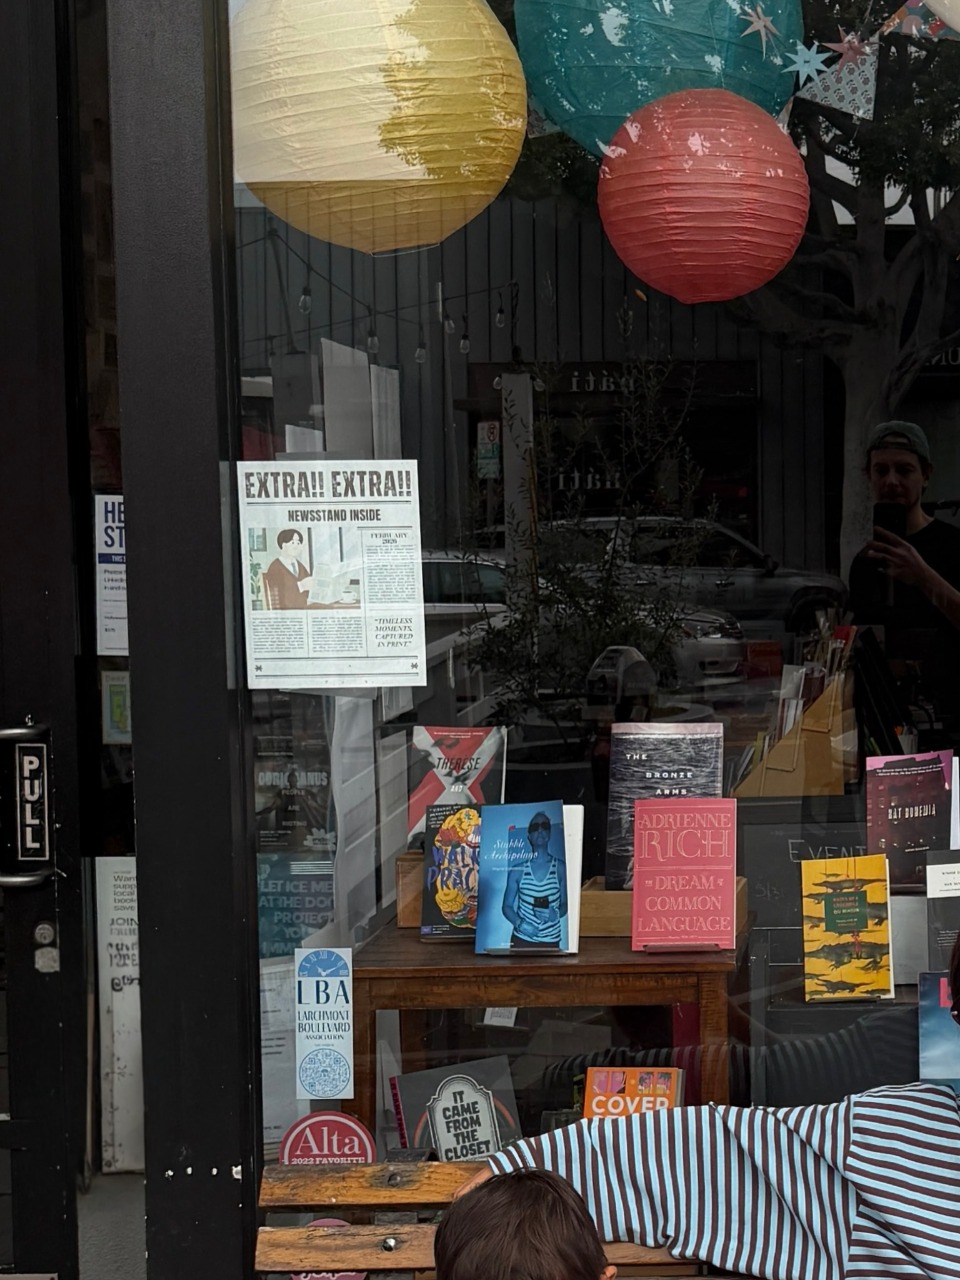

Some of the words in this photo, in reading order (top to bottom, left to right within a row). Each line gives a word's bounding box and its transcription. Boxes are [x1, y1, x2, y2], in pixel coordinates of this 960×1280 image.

[245, 471, 325, 498] EXTRA!!
[331, 470, 412, 497] EXTRA!!
[288, 509, 347, 522] NEWSSTAND
[350, 509, 381, 521] INSIDE
[23, 755, 42, 849] PULL
[638, 813, 731, 829] ADRIENNE
[639, 830, 731, 861] RICH
[260, 880, 283, 893] LET
[286, 880, 308, 893] ICE
[655, 875, 714, 891] DREAM
[645, 896, 722, 911] COMMON
[637, 916, 731, 932] LANGUAGE
[297, 980, 350, 1004] LBA
[297, 1010, 349, 1021] LARCHMONT
[298, 1022, 351, 1033] BOULEVARD
[452, 1090, 465, 1104] IT
[442, 1101, 480, 1120] CAME
[446, 1116, 481, 1133] FROM
[294, 1126, 361, 1155] Alta
[453, 1129, 478, 1145] THE
[444, 1140, 491, 1161] CLOSET
